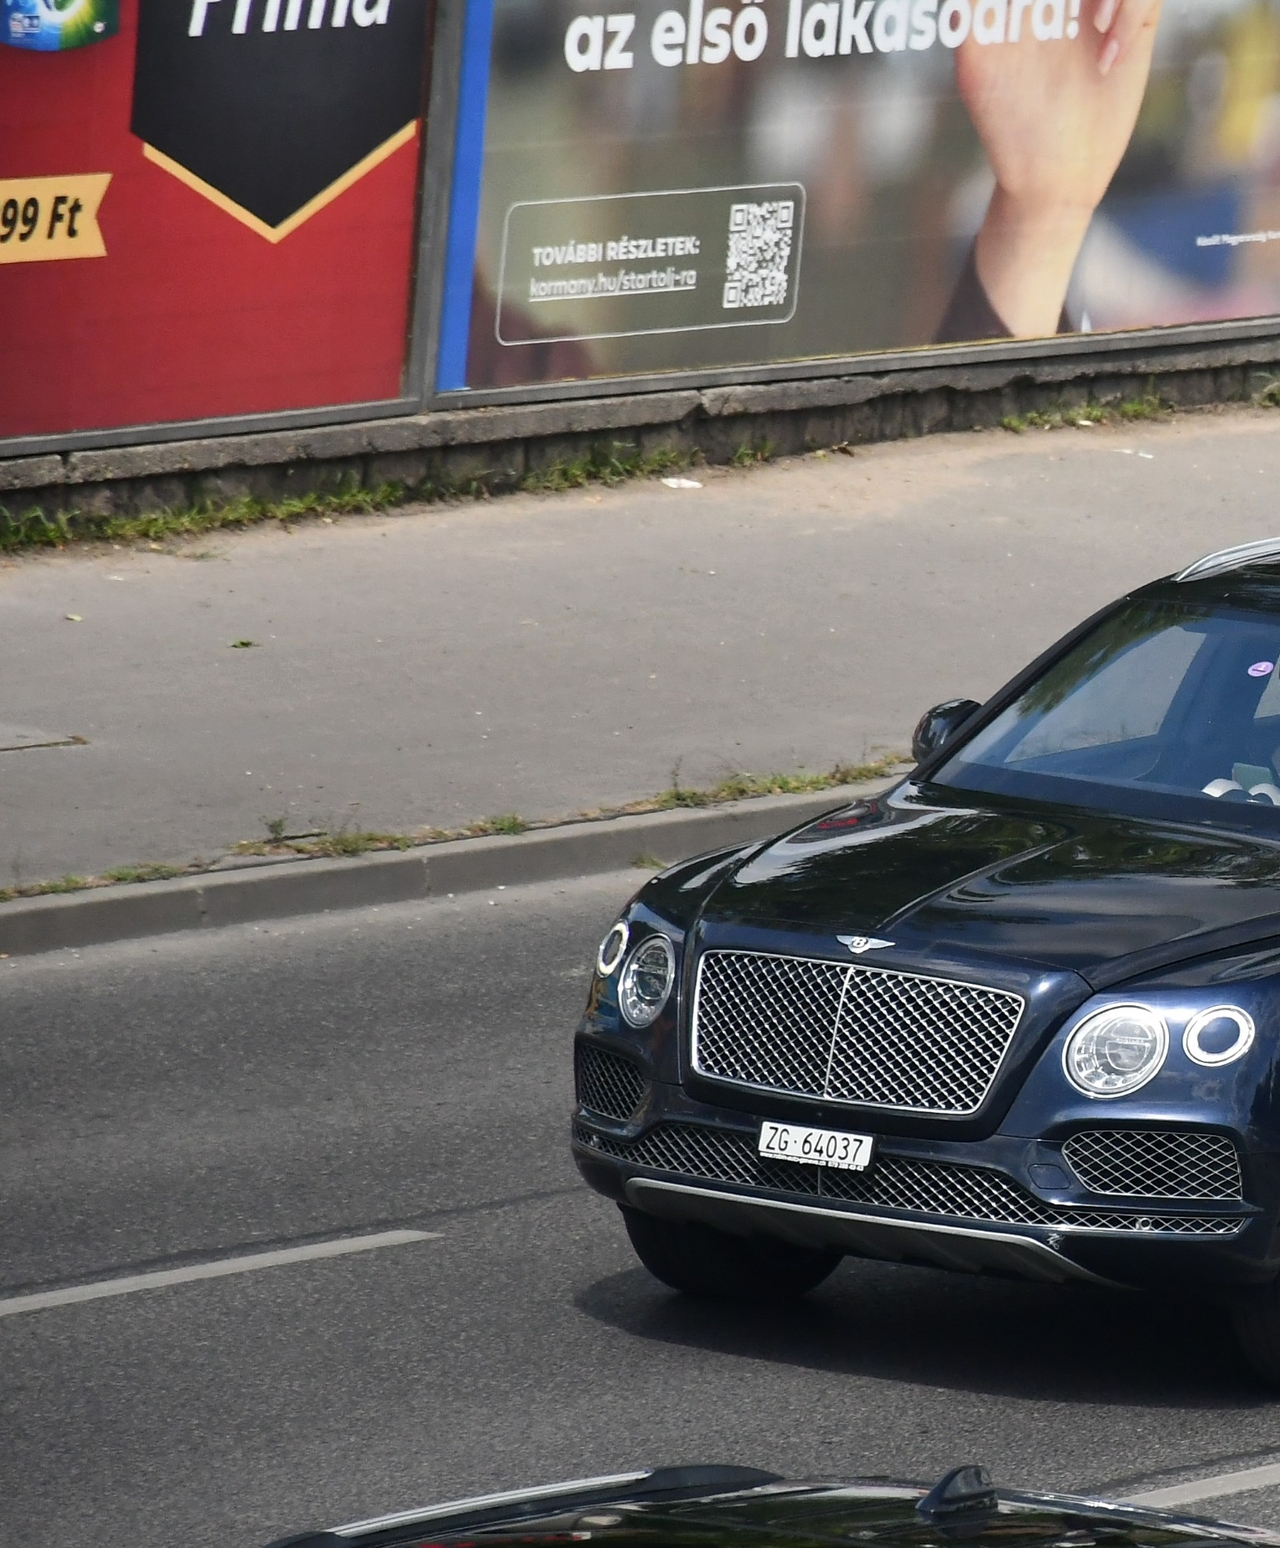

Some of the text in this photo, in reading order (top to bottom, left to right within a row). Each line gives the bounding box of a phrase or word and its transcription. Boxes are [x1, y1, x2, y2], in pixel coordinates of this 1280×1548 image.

[564, 13, 636, 72] az
[651, 0, 768, 67] első
[0, 195, 83, 243] 99 Ft
[532, 235, 700, 267] TOVÁBBI RÉSZLETEK:
